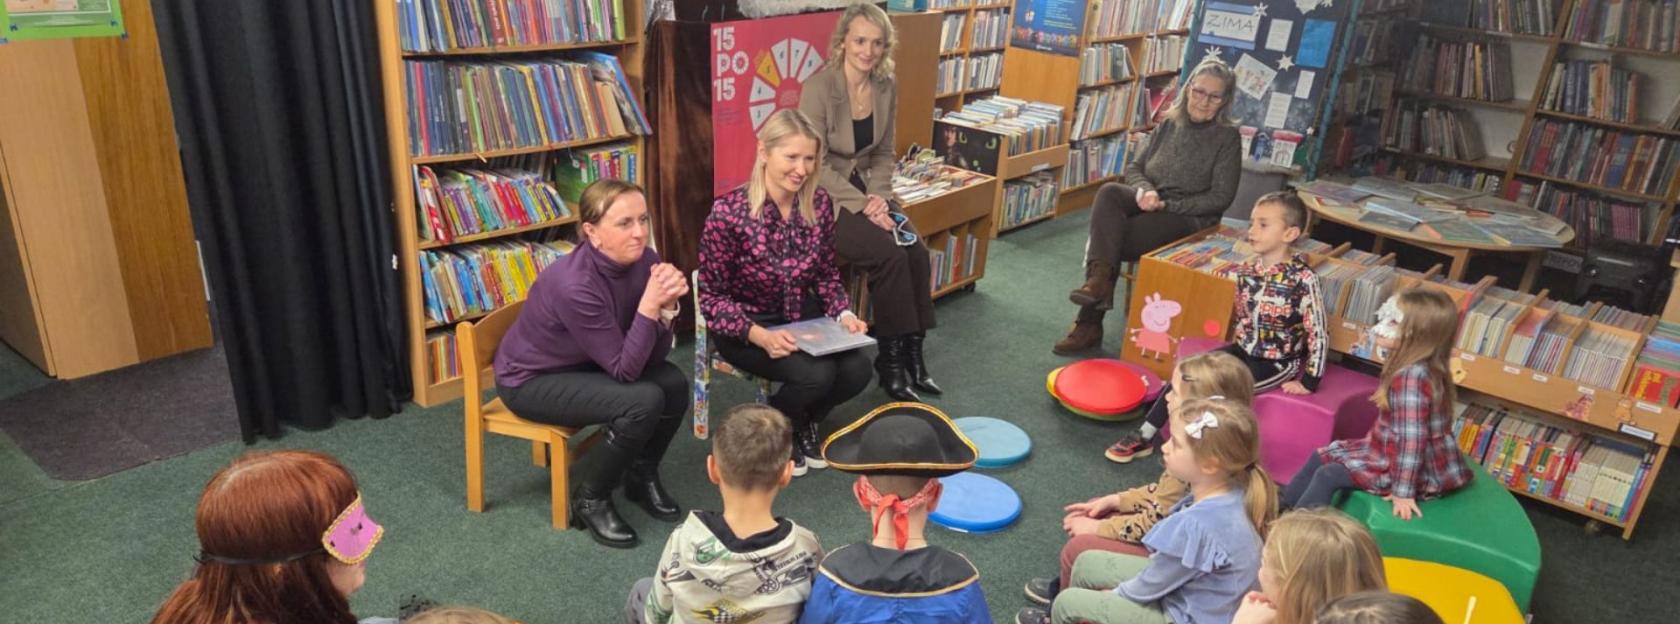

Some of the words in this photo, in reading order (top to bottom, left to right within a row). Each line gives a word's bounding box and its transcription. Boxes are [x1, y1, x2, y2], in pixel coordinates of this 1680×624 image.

[1206, 14, 1254, 32] ZIMA
[713, 27, 735, 51] 15
[713, 77, 736, 102] 15
